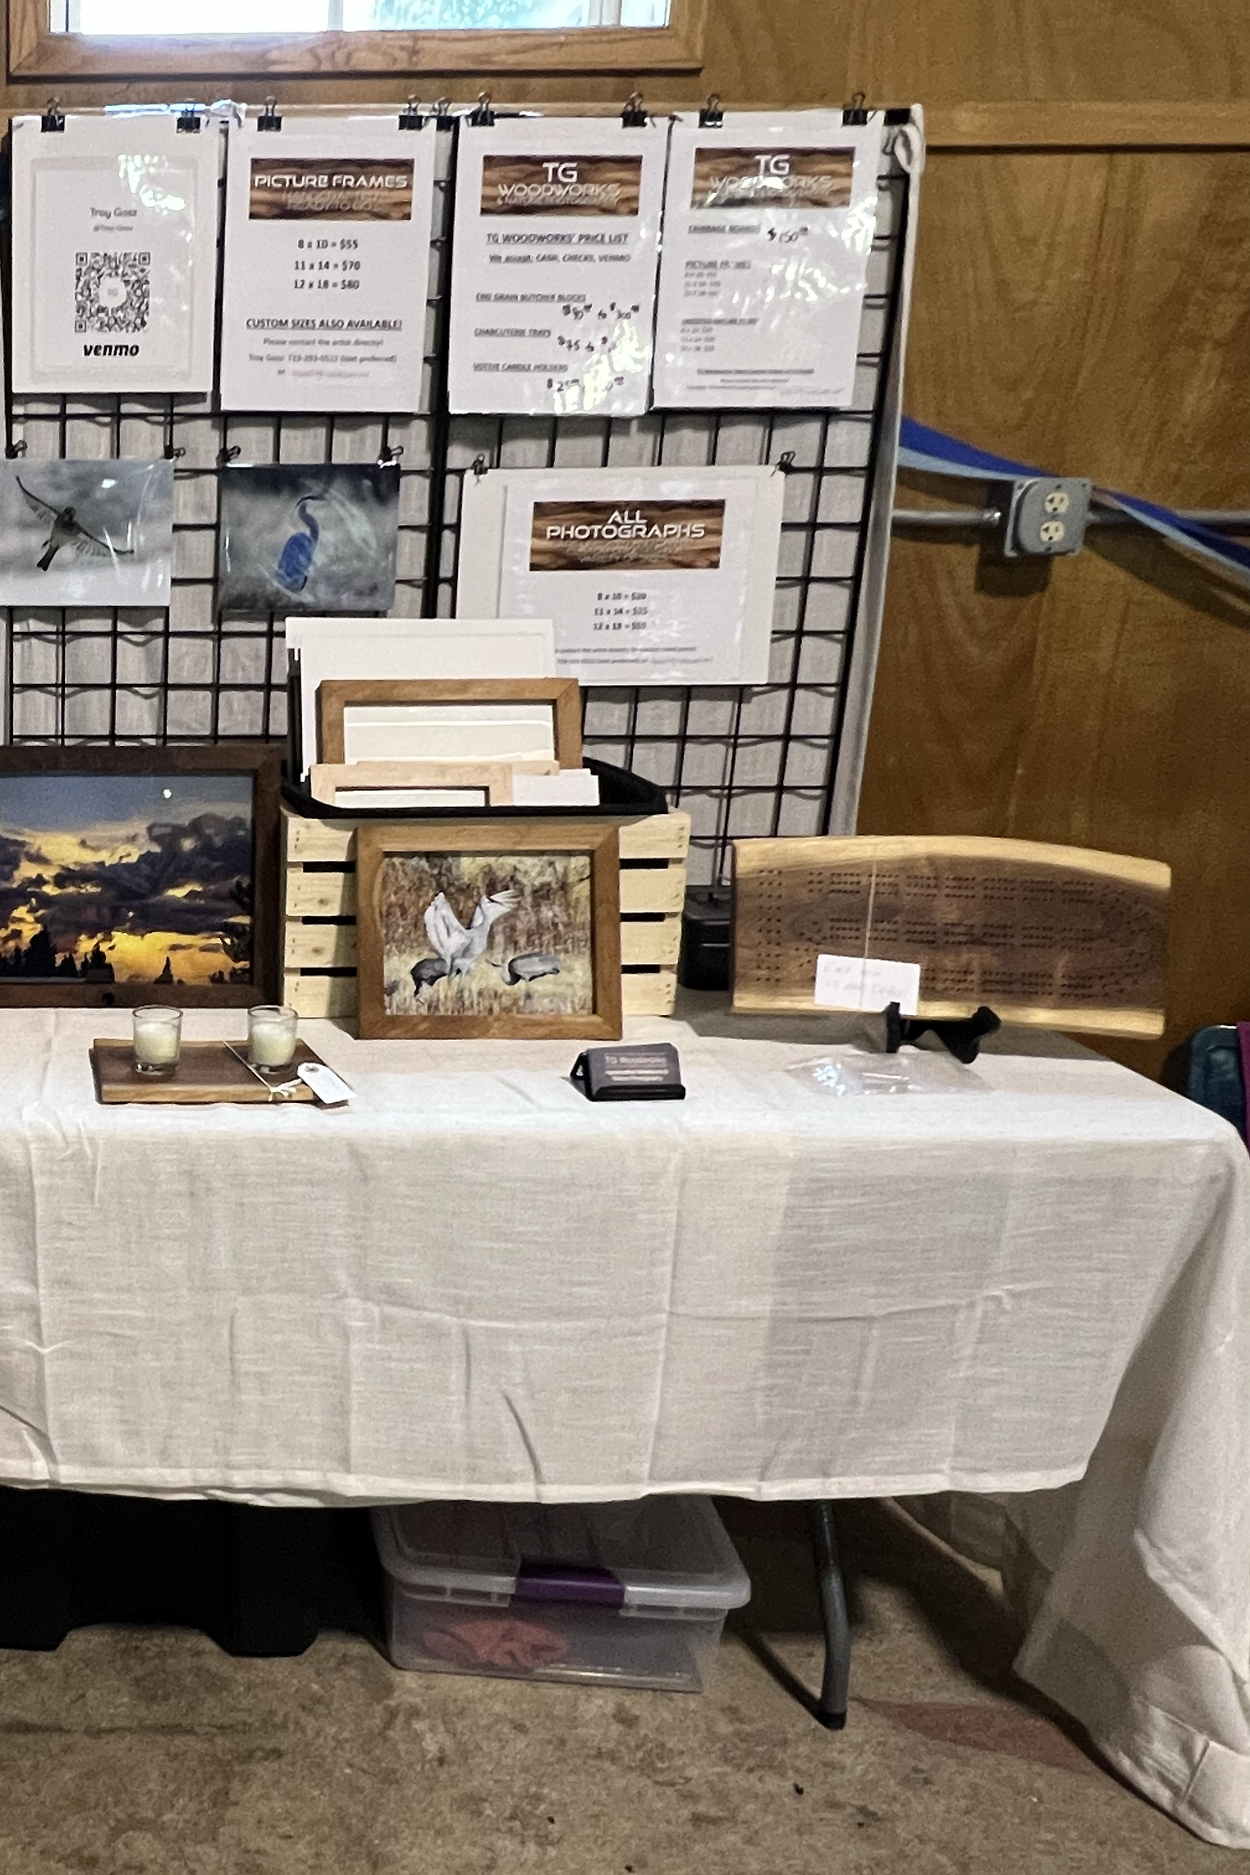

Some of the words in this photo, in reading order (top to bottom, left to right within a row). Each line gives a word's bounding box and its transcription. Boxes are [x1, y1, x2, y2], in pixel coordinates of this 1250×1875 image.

[754, 154, 790, 175] TG
[542, 162, 578, 183] TG
[254, 175, 329, 188] PICTURE
[332, 175, 408, 188] FRAMES
[497, 183, 622, 197] WOODWORKS
[90, 207, 112, 219] Troy
[294, 261, 306, 270] 11
[318, 261, 330, 270] 14
[342, 260, 361, 271] $70
[246, 318, 289, 328] CUSTOM
[291, 319, 316, 328] SIZES
[318, 319, 344, 329] ALSO
[83, 344, 140, 356] venmo
[607, 509, 648, 524] ALL
[546, 524, 706, 540] PHOTOGRAPHS
